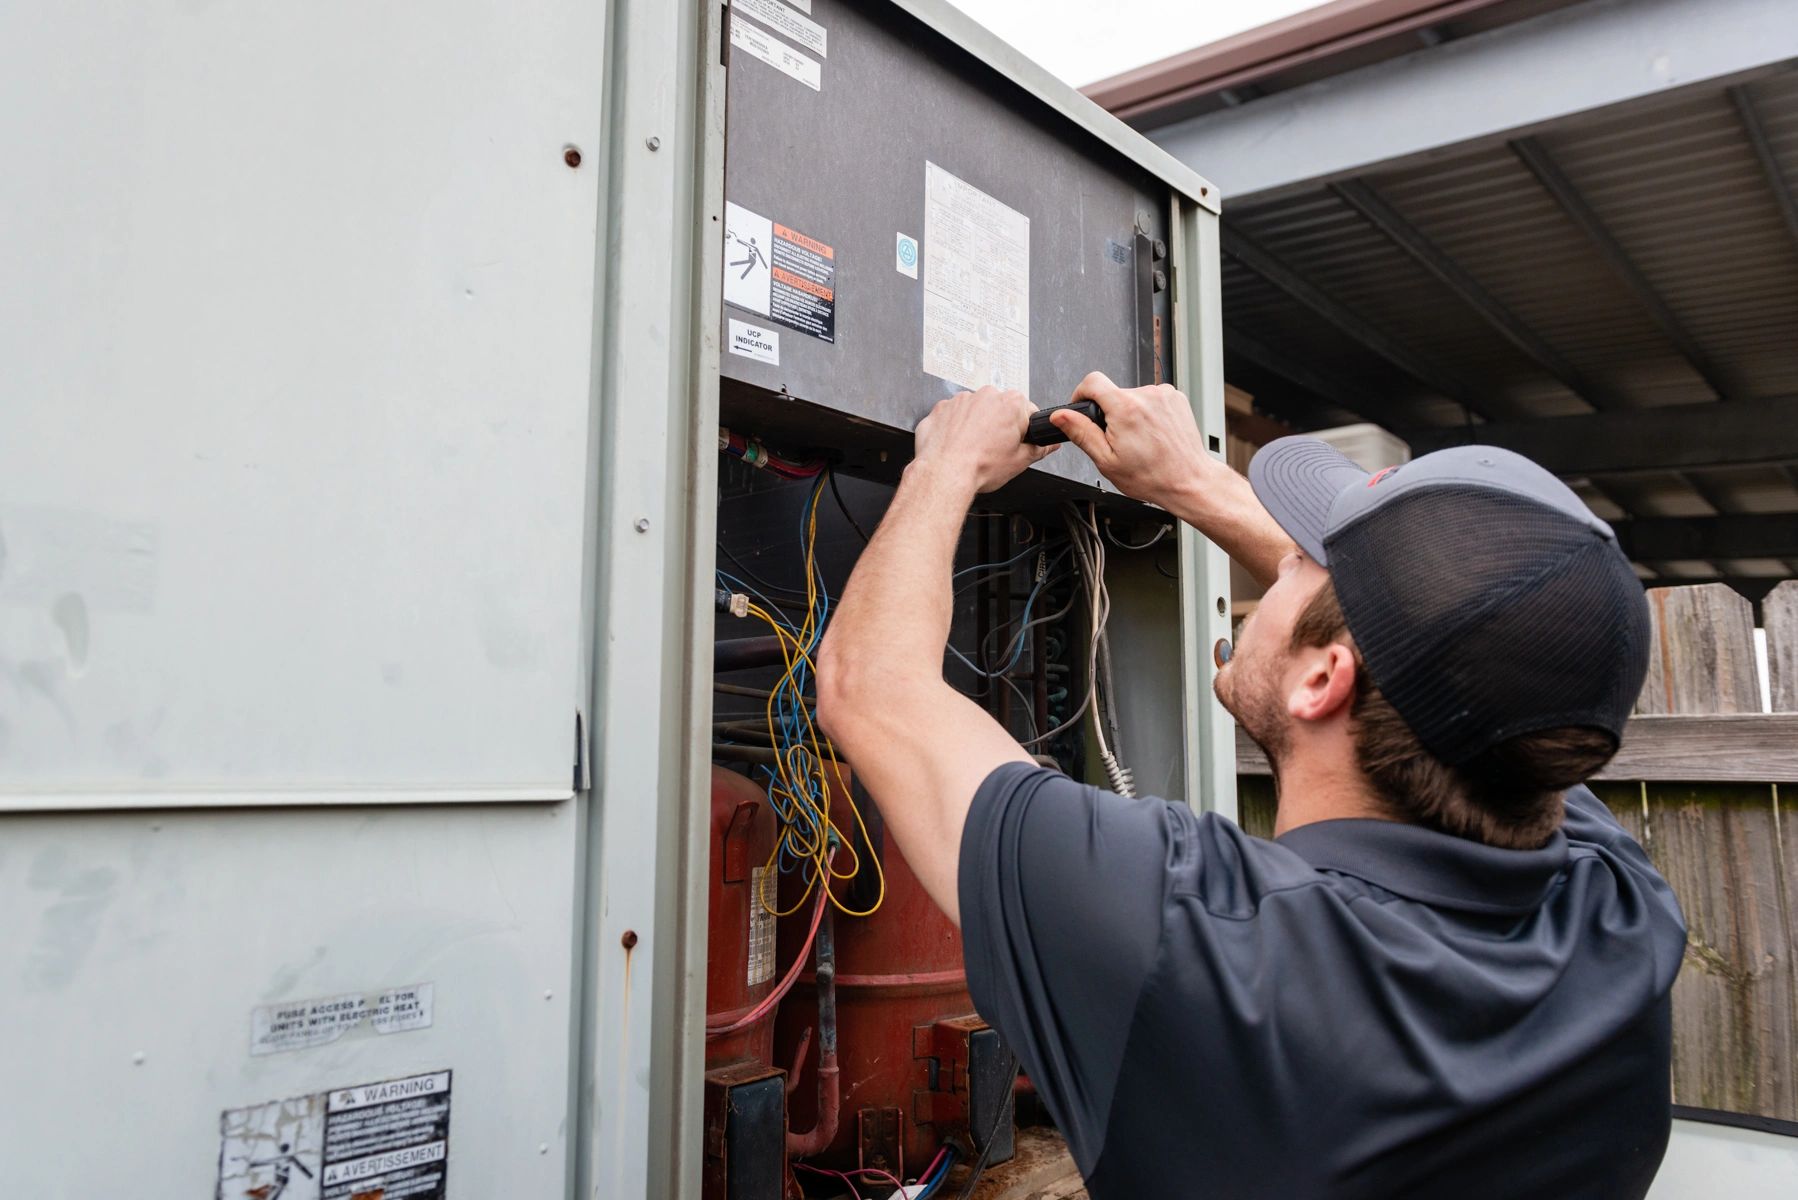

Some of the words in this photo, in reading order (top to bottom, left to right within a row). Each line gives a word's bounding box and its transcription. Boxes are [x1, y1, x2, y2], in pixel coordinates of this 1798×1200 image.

[790, 231, 827, 254] WARNING
[735, 335, 773, 352] INDICATOR
[747, 329, 762, 338] UCP
[270, 1019, 304, 1033] UNITS
[308, 1014, 336, 1027] WITH
[339, 1006, 390, 1022] ELECTRIC
[393, 1001, 420, 1013] HEAT
[276, 1007, 306, 1020] FUSE
[310, 1001, 354, 1015] ACCESS
[357, 995, 391, 1008] PEL
[395, 992, 415, 1002] FOR
[364, 1078, 434, 1102] WARNING
[343, 1144, 442, 1177] AVERTISSEMENT
